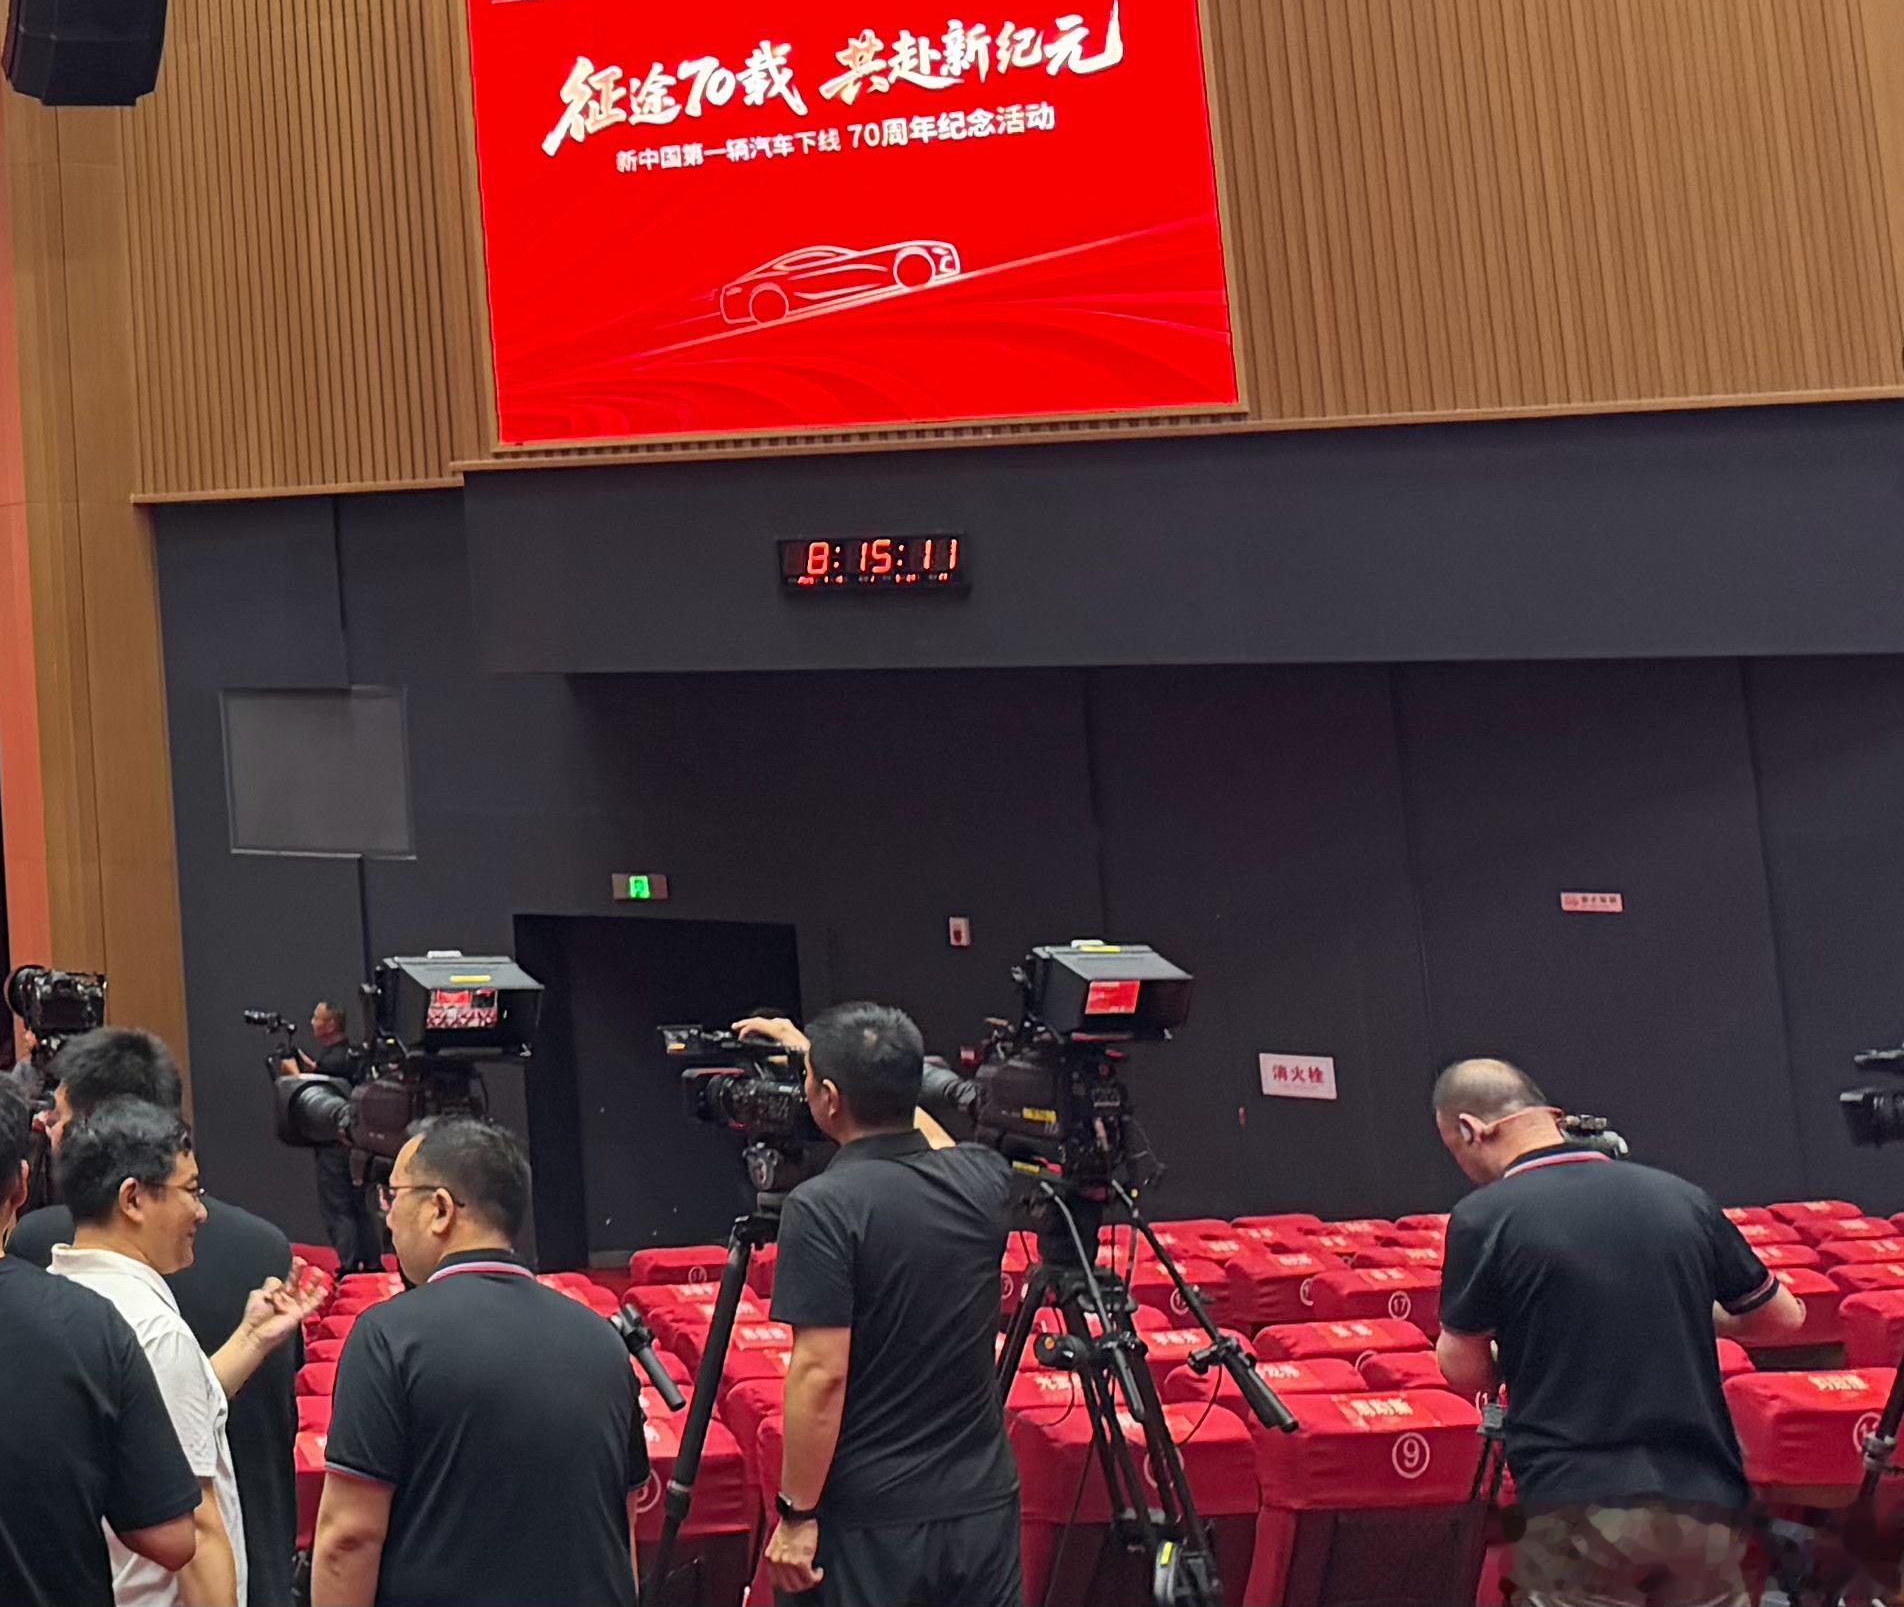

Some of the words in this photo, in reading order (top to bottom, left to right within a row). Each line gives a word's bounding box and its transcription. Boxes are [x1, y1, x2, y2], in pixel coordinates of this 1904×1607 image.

[542, 40, 808, 156] 征途70载
[617, 128, 841, 172] 新中国第一辆汽车下线
[848, 102, 1055, 148] 70周年纪念活动
[807, 539, 958, 575] 8:15:11
[1273, 1065, 1323, 1083] 消火栓
